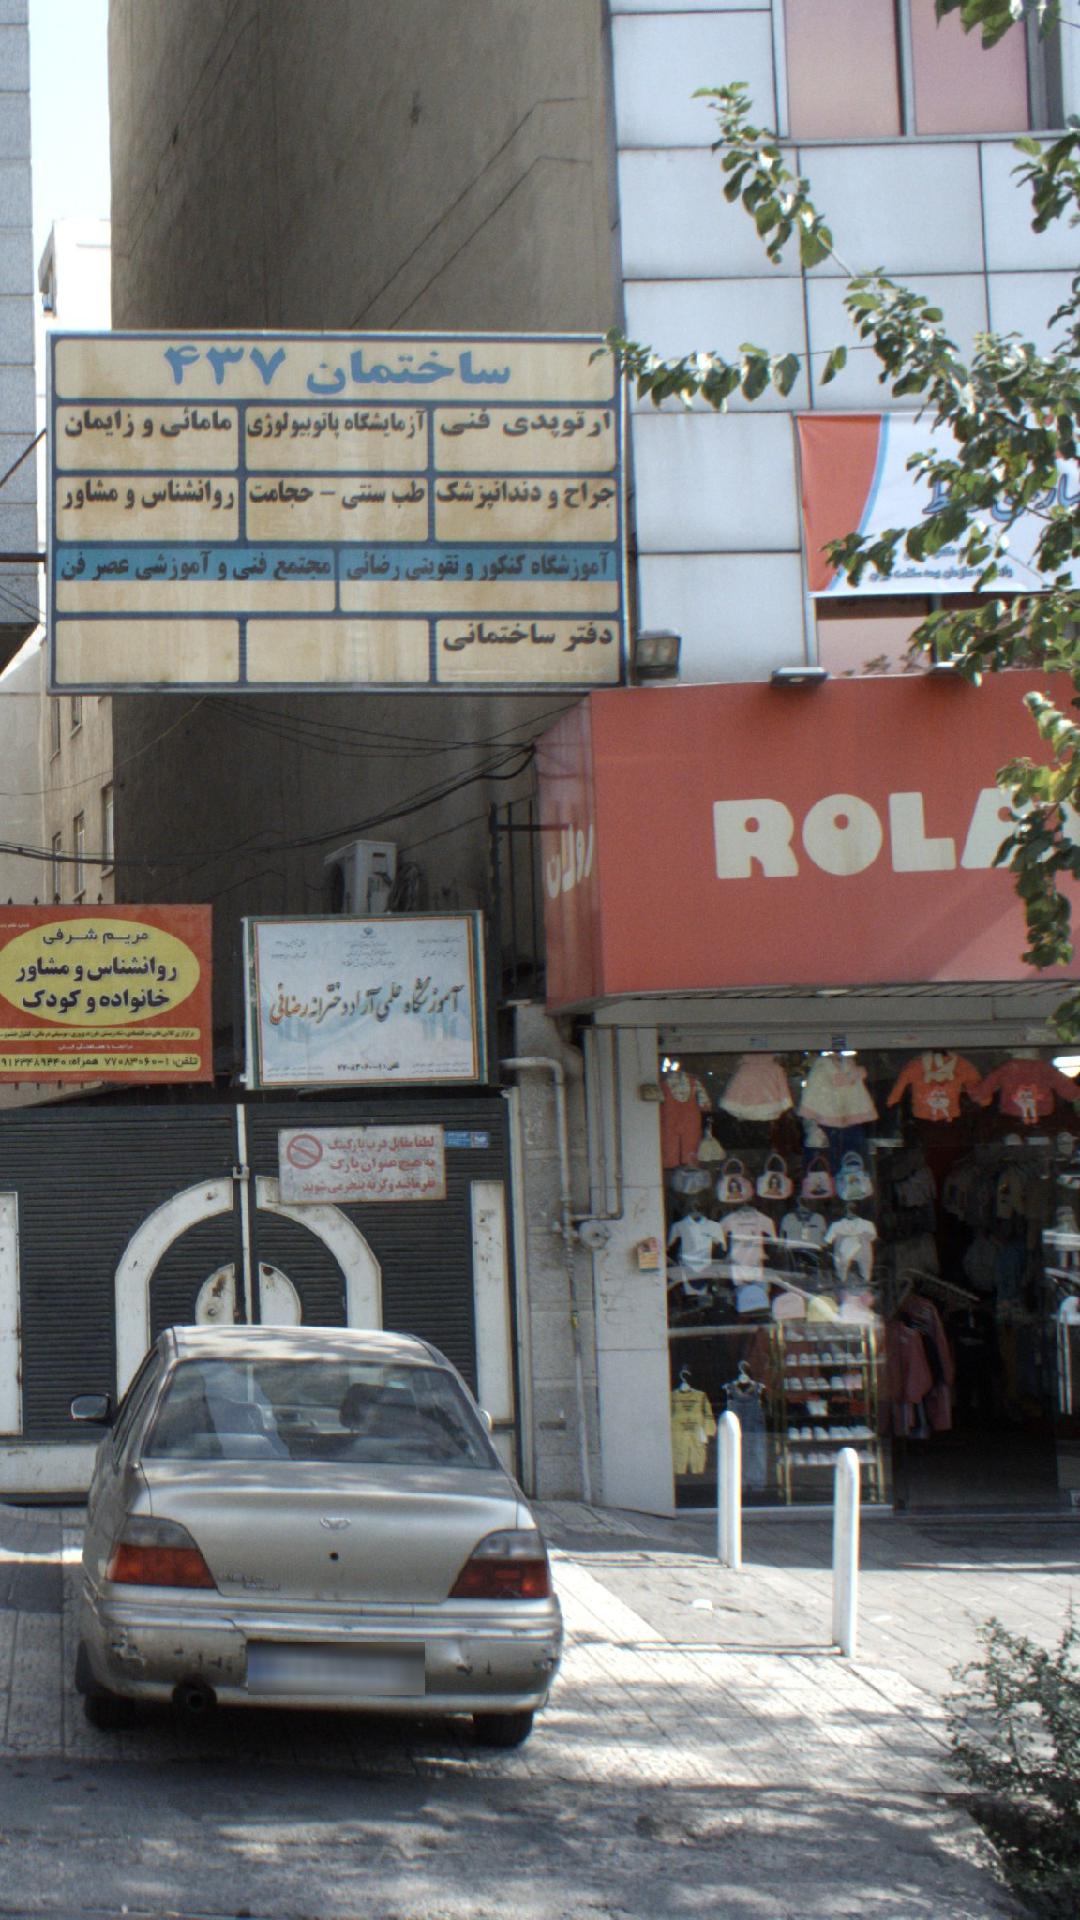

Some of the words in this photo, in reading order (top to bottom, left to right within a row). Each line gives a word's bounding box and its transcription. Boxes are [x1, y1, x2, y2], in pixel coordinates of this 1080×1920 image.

[164, 345, 286, 387] ۴۳۷
[307, 349, 510, 395] ساختمان
[65, 409, 135, 438] زایمان
[142, 418, 154, 437] و
[247, 410, 339, 439] پاتوبیولوژی
[344, 409, 425, 439] آزمایشگاه
[440, 409, 491, 437] فنی
[502, 410, 610, 438] ارتوپدی
[62, 480, 118, 509] مشاور
[124, 489, 135, 509] و
[141, 479, 234, 509] روانشناس
[249, 480, 314, 509] حجامت
[341, 484, 385, 509] سنتی
[391, 481, 425, 509] طب
[436, 481, 542, 509] دندانپزشک
[547, 490, 559, 509] و
[563, 480, 615, 509] جراح
[61, 551, 86, 580] فن
[91, 558, 129, 581] عصر
[135, 550, 212, 580] آموزشی
[217, 562, 227, 580] و
[232, 553, 267, 580] فنی
[273, 556, 331, 581] مجتمع
[405, 554, 459, 581] تقویتی
[464, 563, 473, 581] و
[478, 554, 526, 581] کنکور
[531, 551, 611, 581] آموزشگاه
[443, 623, 555, 652] ساختمانی
[562, 624, 613, 652] دفتر
[713, 787, 1080, 879] ROLA
[42, 928, 97, 945] شرفی
[102, 930, 148, 945] مریم
[16, 957, 69, 982] مشاور
[74, 964, 83, 981] و
[87, 956, 177, 981] روانشناس
[22, 989, 82, 1013] کودک
[85, 998, 95, 1013] و
[100, 988, 170, 1013] خانواده
[376, 982, 402, 1022] علمی
[403, 976, 465, 1014] آموزشگاه
